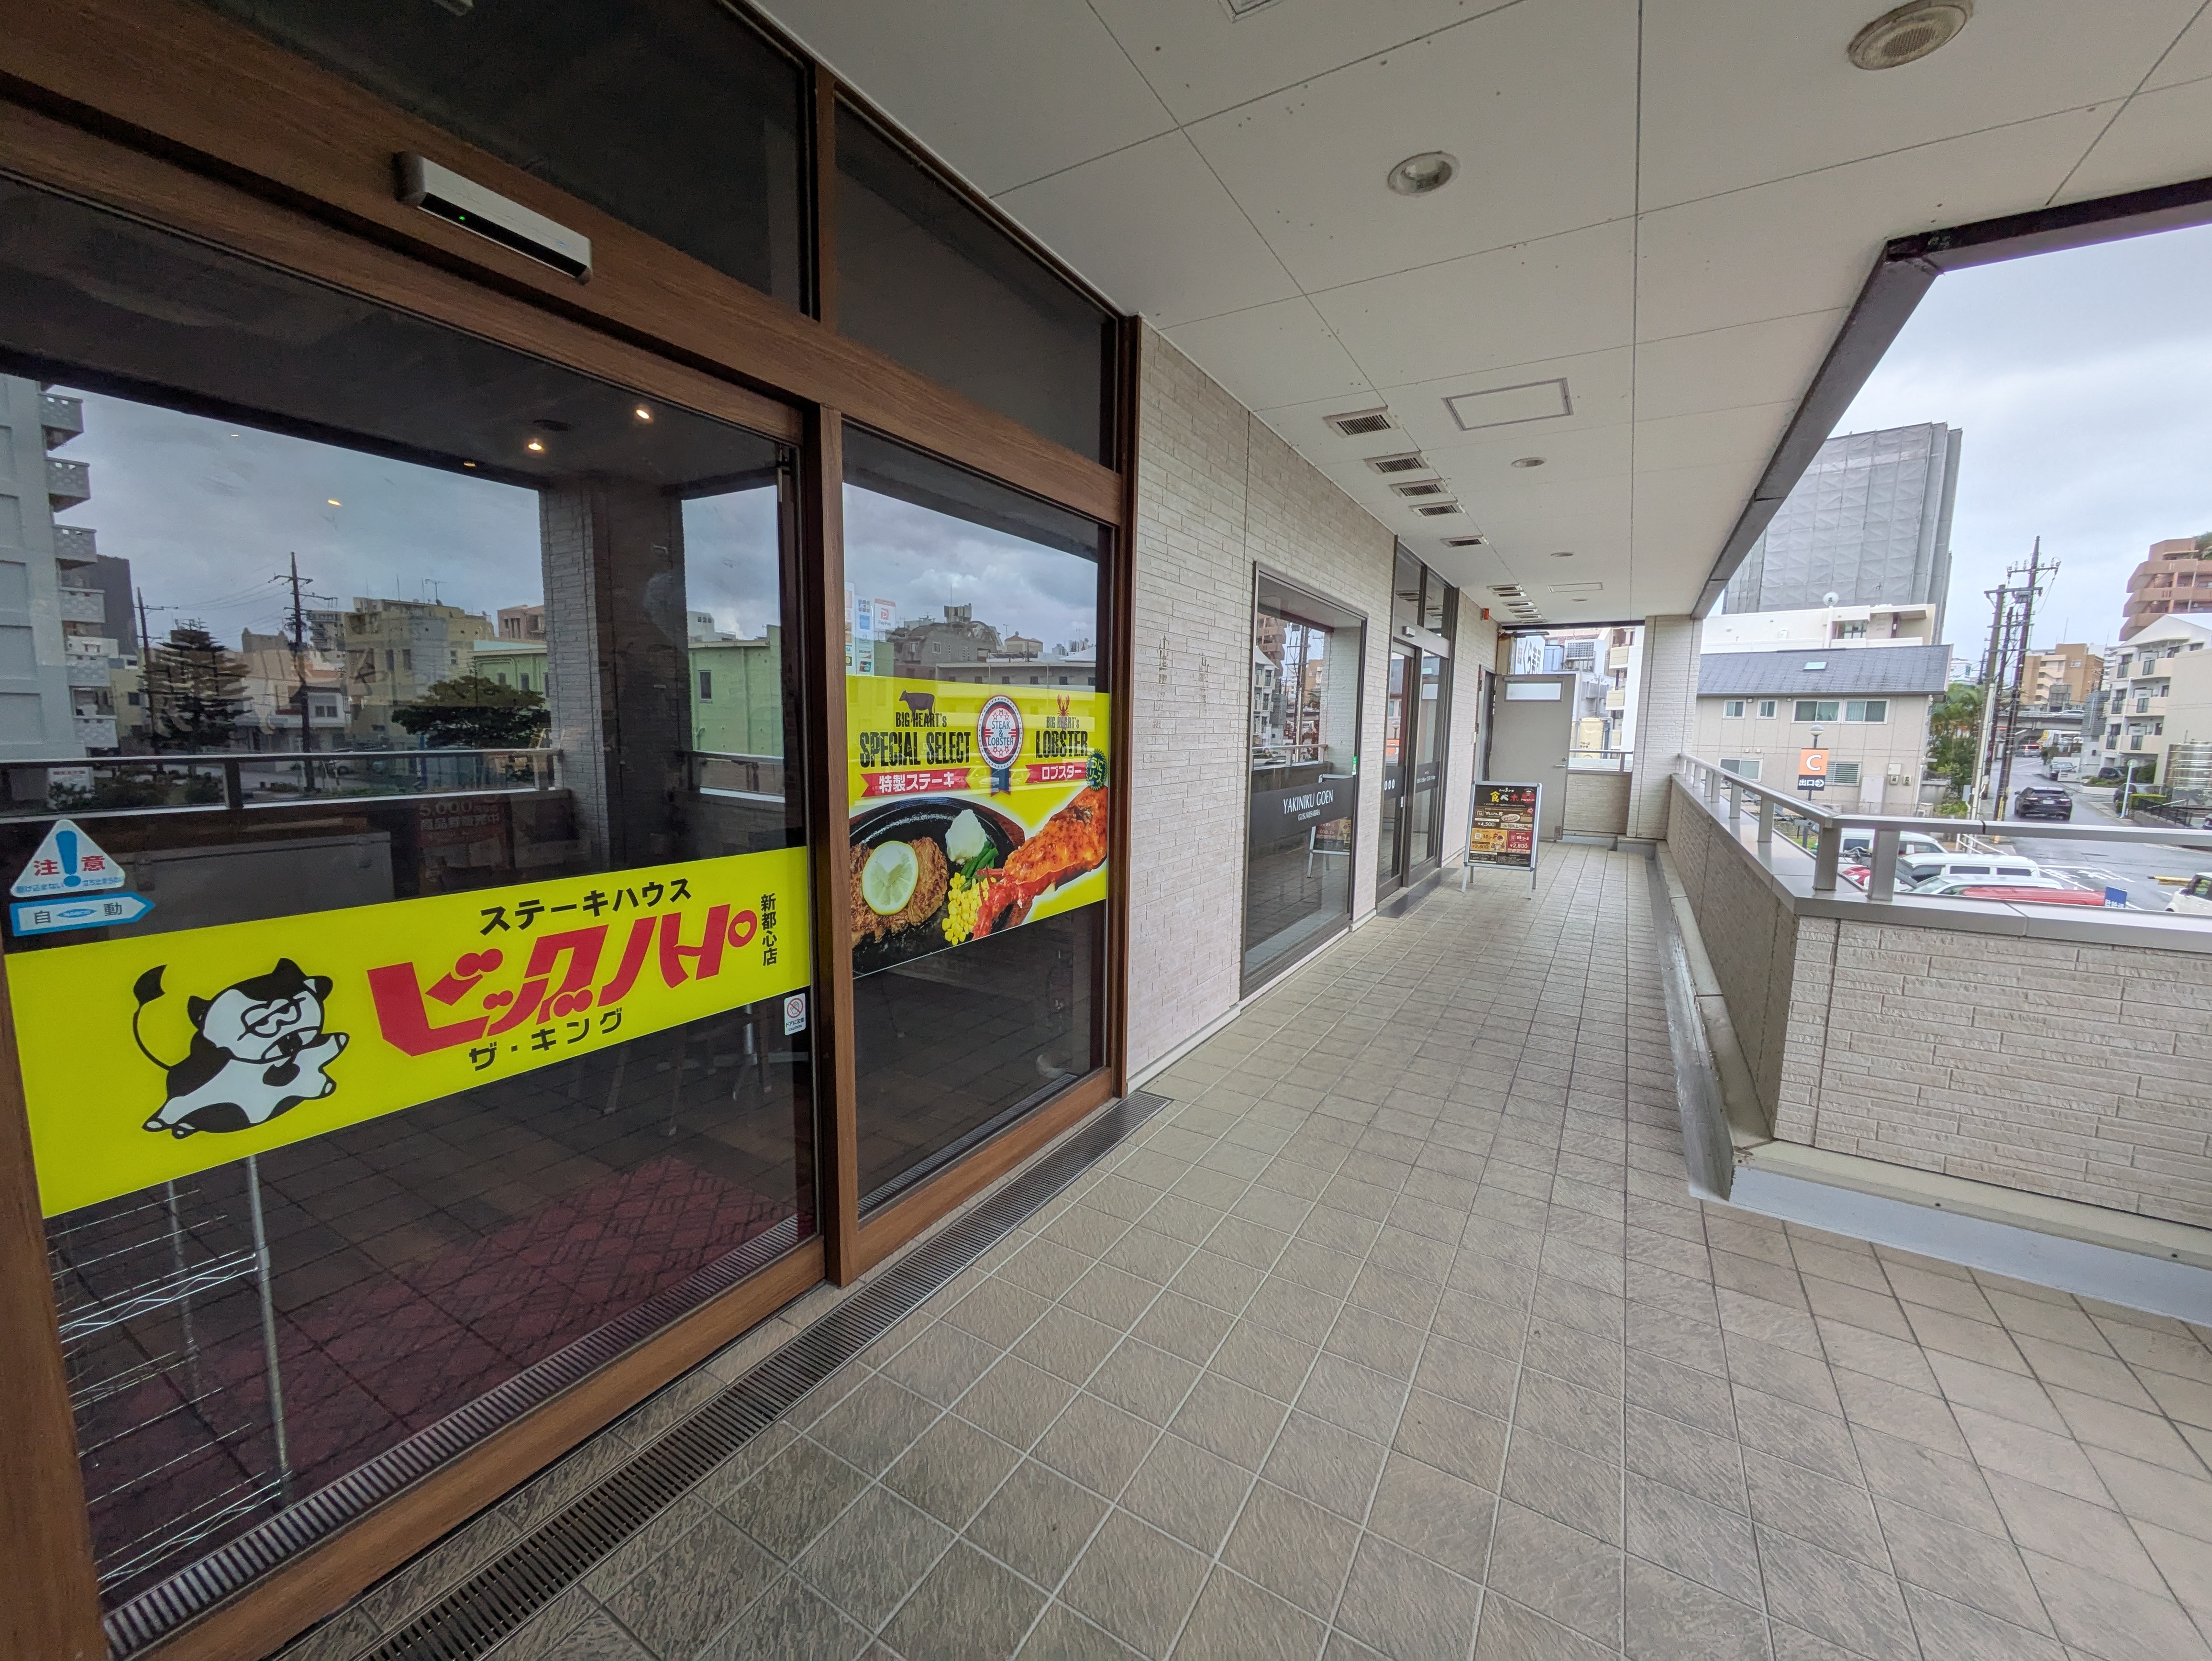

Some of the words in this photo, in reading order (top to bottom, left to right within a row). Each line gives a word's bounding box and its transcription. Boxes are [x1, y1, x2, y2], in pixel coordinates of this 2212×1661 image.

[896, 712, 910, 727] BIG
[992, 720, 1011, 729] STEAK
[1046, 716, 1056, 729] BIG
[988, 737, 1014, 746] LOBSTER
[998, 729, 1004, 737] &
[860, 731, 921, 768] SPECIAL
[926, 731, 971, 765] SELECT
[1036, 730, 1088, 759] LOBSTER
[1091, 757, 1104, 772] うに
[1805, 753, 1822, 771] C
[879, 772, 955, 793] 特製ステーキ
[1799, 778, 1815, 786] 出口
[1283, 793, 1315, 814] YAKINIKU
[1316, 789, 1334, 806] GOEN
[479, 878, 692, 936] ステーキハウス
[760, 894, 779, 967] 新都心店
[468, 1007, 623, 1072] ザ・キング
